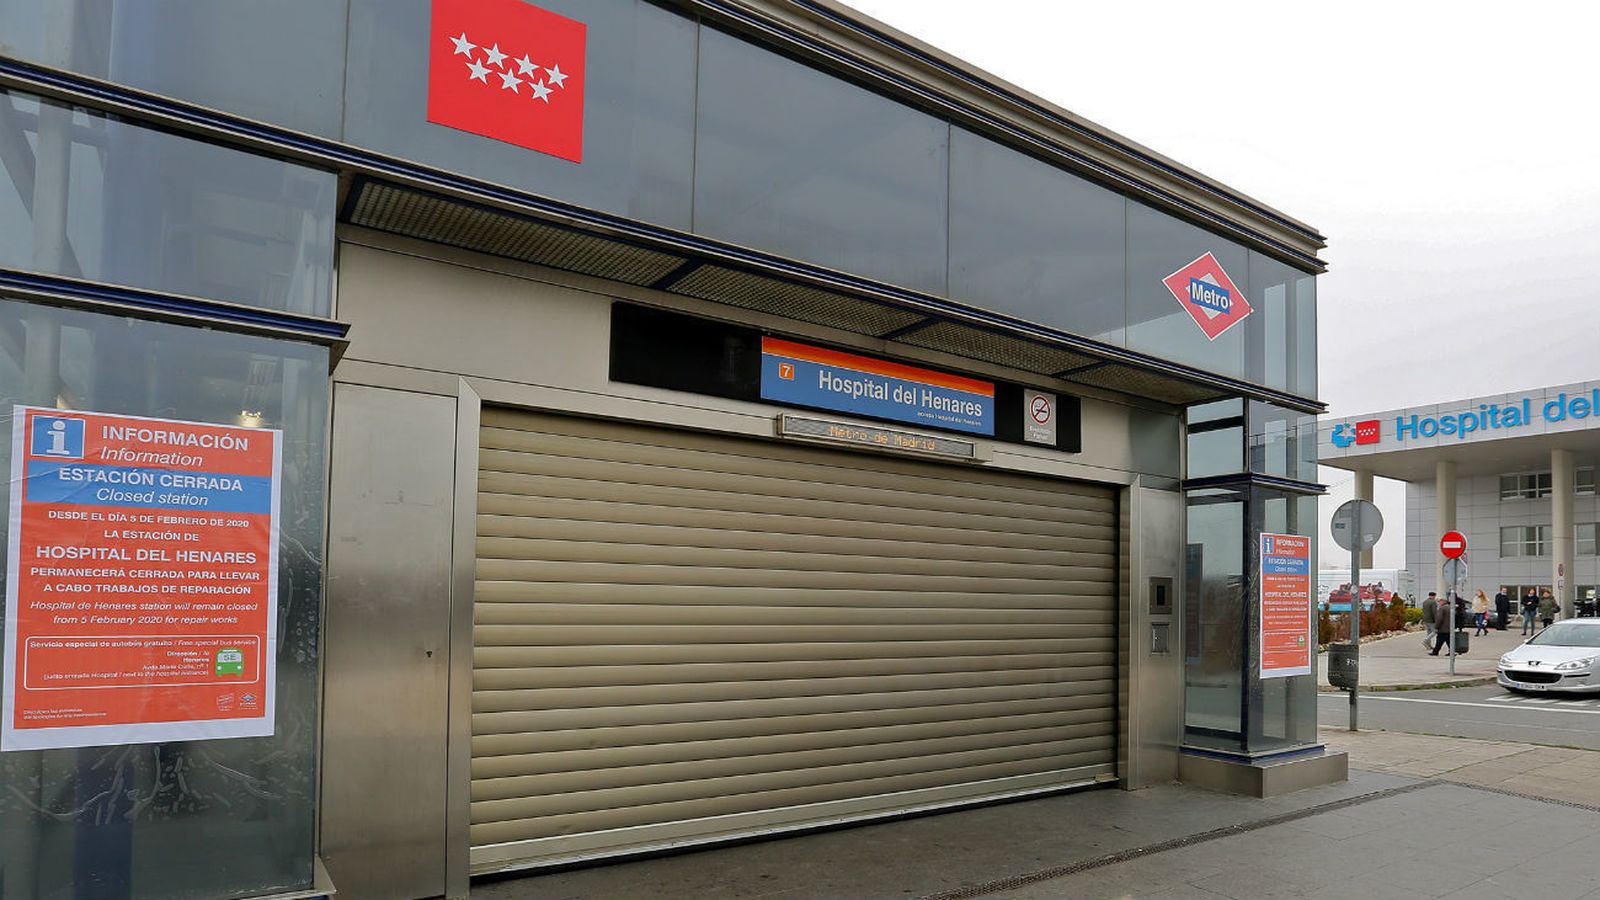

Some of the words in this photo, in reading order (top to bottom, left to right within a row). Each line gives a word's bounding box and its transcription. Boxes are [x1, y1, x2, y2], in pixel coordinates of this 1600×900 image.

[1192, 282, 1228, 309] Metro
[783, 366, 791, 378] 7
[818, 370, 888, 401] Hospital
[892, 384, 917, 404] del
[922, 390, 982, 417] Henares
[1396, 398, 1530, 438] Hospital
[1542, 388, 1600, 422] del
[102, 425, 248, 450] INFORMACIÓN
[828, 426, 867, 441] Metro
[874, 432, 889, 444] de
[894, 434, 936, 450] Madrid
[100, 446, 203, 467] Information
[59, 467, 154, 486] ESTACIÓN
[160, 473, 243, 492] CERRADA
[96, 488, 154, 504] Closed
[158, 492, 208, 506] station
[48, 510, 88, 520] DESDE
[91, 512, 104, 522] EL
[108, 511, 128, 522] DÍA
[130, 515, 136, 523] 5
[140, 514, 154, 523] DE
[157, 516, 206, 526] FEBRERO
[210, 518, 224, 526] DE
[226, 518, 249, 528] 2020
[104, 530, 120, 538] LA
[122, 530, 181, 541] ESTACIÓN
[184, 533, 200, 541] DE
[36, 546, 131, 560] HOSPITAL
[136, 548, 171, 562] DEL
[176, 550, 256, 564] HENARES
[30, 566, 126, 578] PERMANECERÁ
[129, 570, 185, 580] CERRADA
[188, 571, 217, 580] PARA
[220, 572, 260, 580] LLEVAR
[44, 584, 52, 592] A
[56, 584, 92, 592] CABO
[96, 584, 158, 594] TRABAJOS
[162, 585, 176, 594] DE
[180, 584, 251, 594] REPARACIÓN
[30, 601, 74, 612] Hospital
[77, 602, 91, 610] de
[94, 602, 136, 611] Henares
[140, 602, 172, 611] station
[174, 603, 190, 611] will
[192, 603, 224, 611] remain
[227, 602, 258, 611] closed
[54, 616, 77, 624] from
[90, 615, 136, 626] February
[138, 616, 163, 624] 2020
[165, 615, 179, 624] for
[180, 616, 208, 626] repair
[210, 616, 238, 624] works
